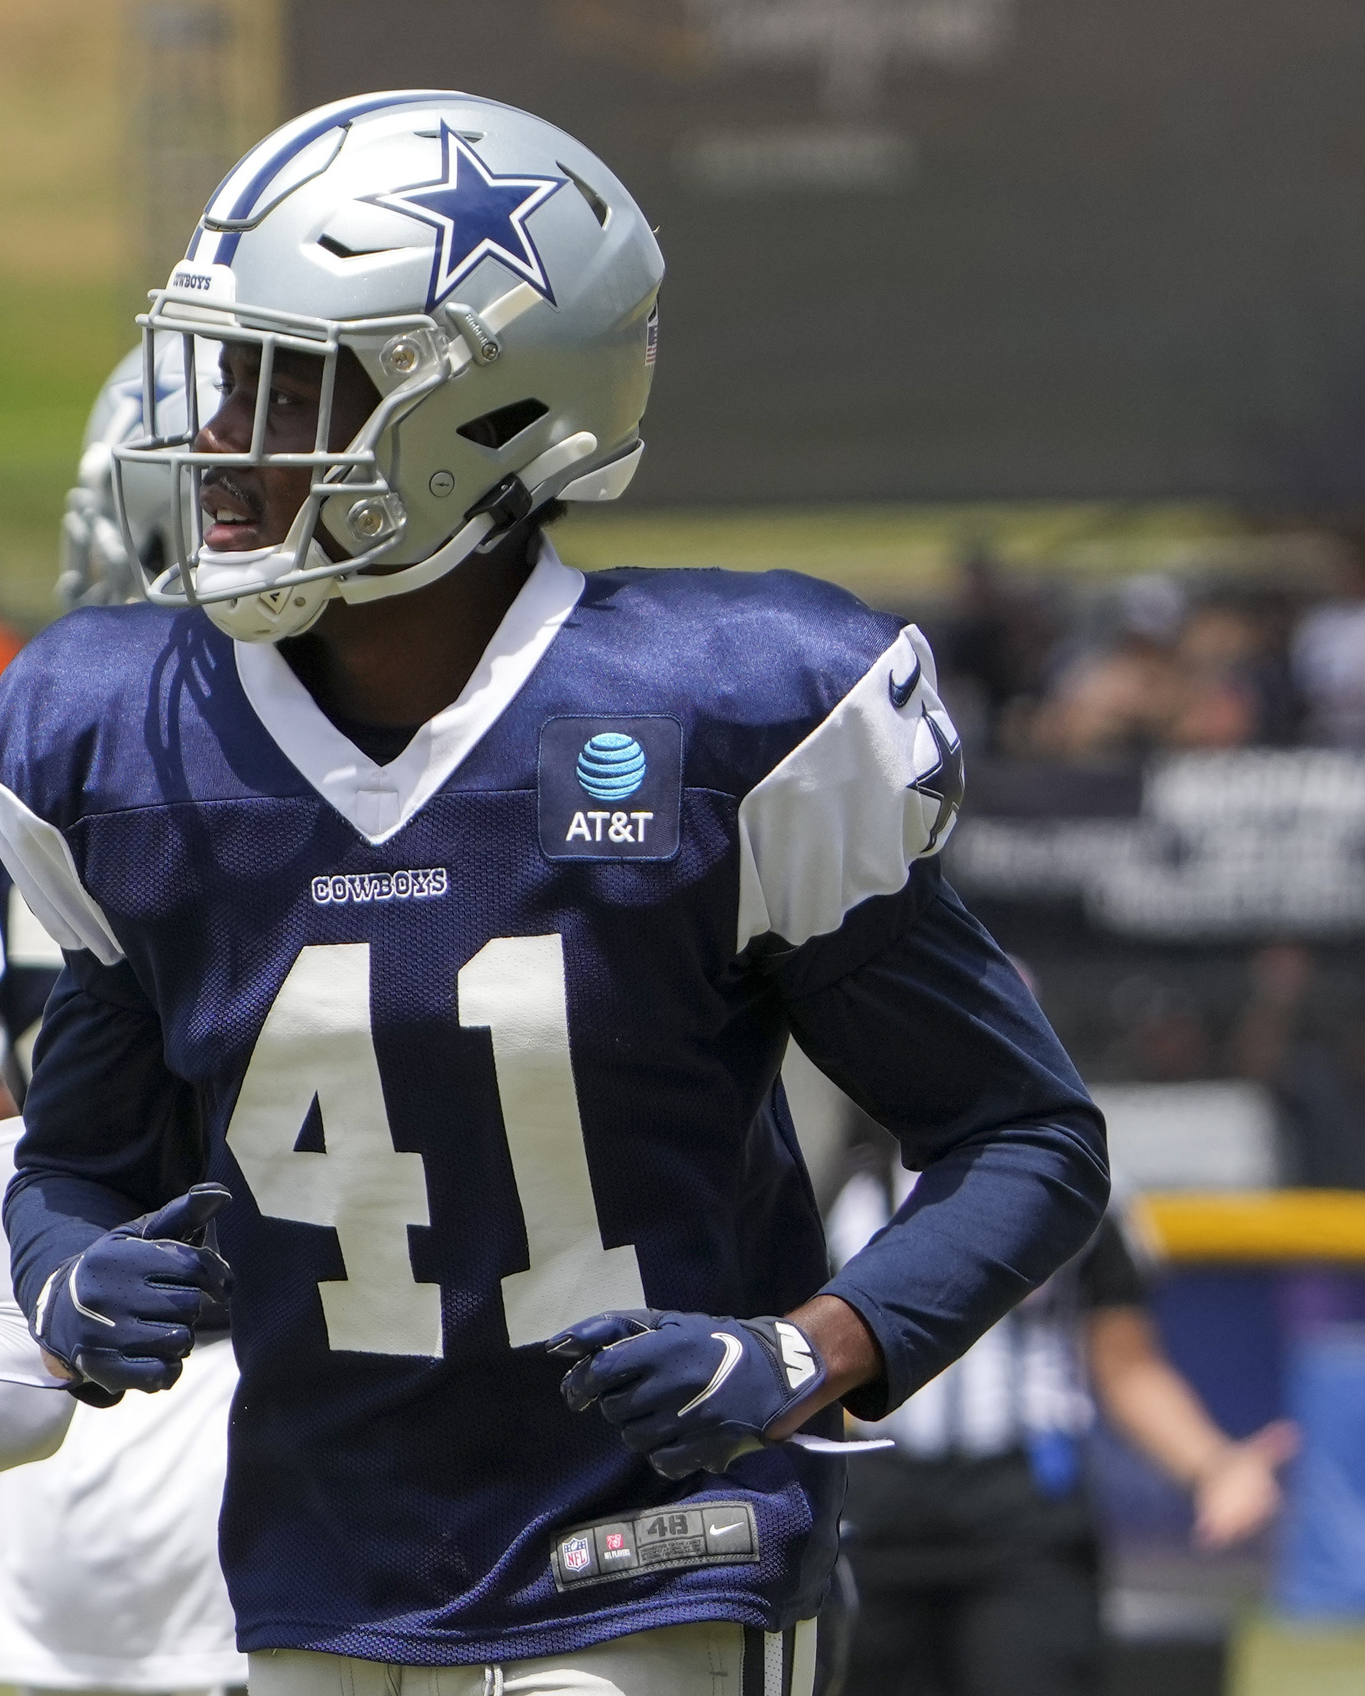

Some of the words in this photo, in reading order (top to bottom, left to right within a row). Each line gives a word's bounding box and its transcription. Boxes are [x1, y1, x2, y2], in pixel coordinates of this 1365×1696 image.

[565, 810, 655, 844] AT&T
[310, 867, 448, 904] COWBOYS
[225, 932, 647, 1359] 41
[647, 1513, 689, 1538] 48
[566, 1550, 587, 1567] NFL
